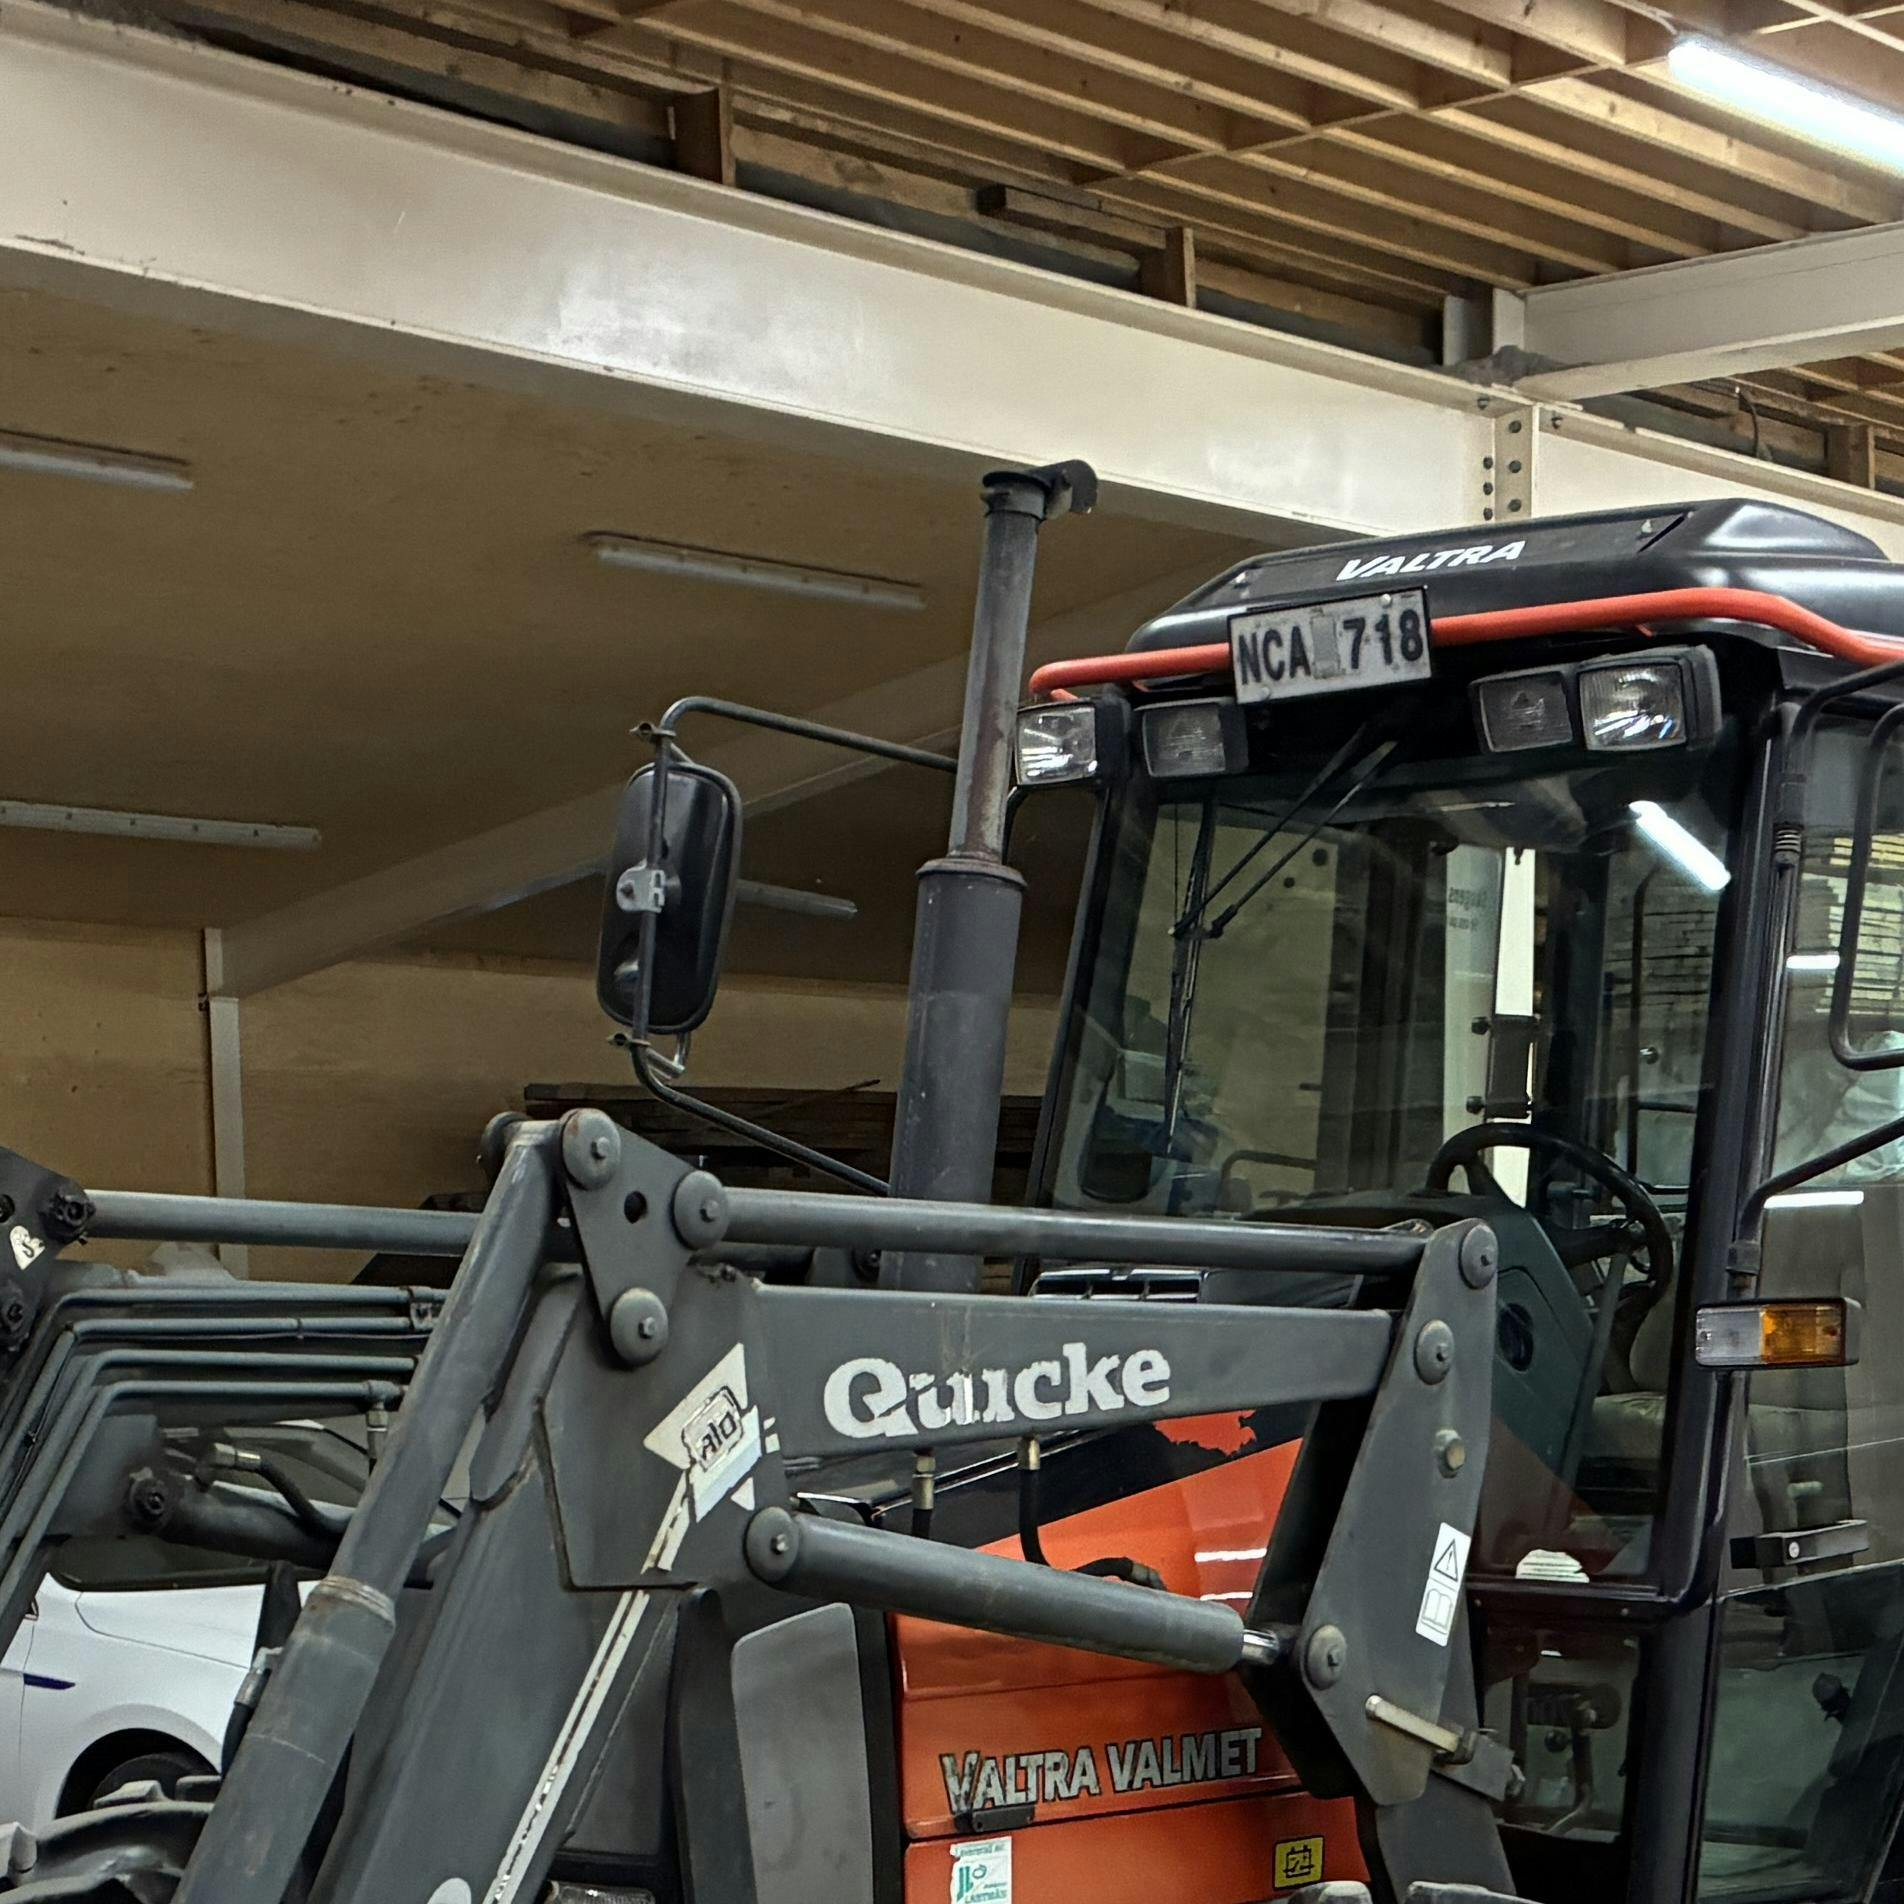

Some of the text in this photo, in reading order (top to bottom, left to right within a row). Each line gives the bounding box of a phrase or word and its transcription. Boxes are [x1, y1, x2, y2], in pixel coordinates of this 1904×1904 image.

[1336, 540, 1526, 581] VALTRA
[1237, 609, 1424, 685] NCA 718
[823, 1342, 1171, 1438] Quicke
[939, 1727, 1263, 1813] VALTRA VALMET
